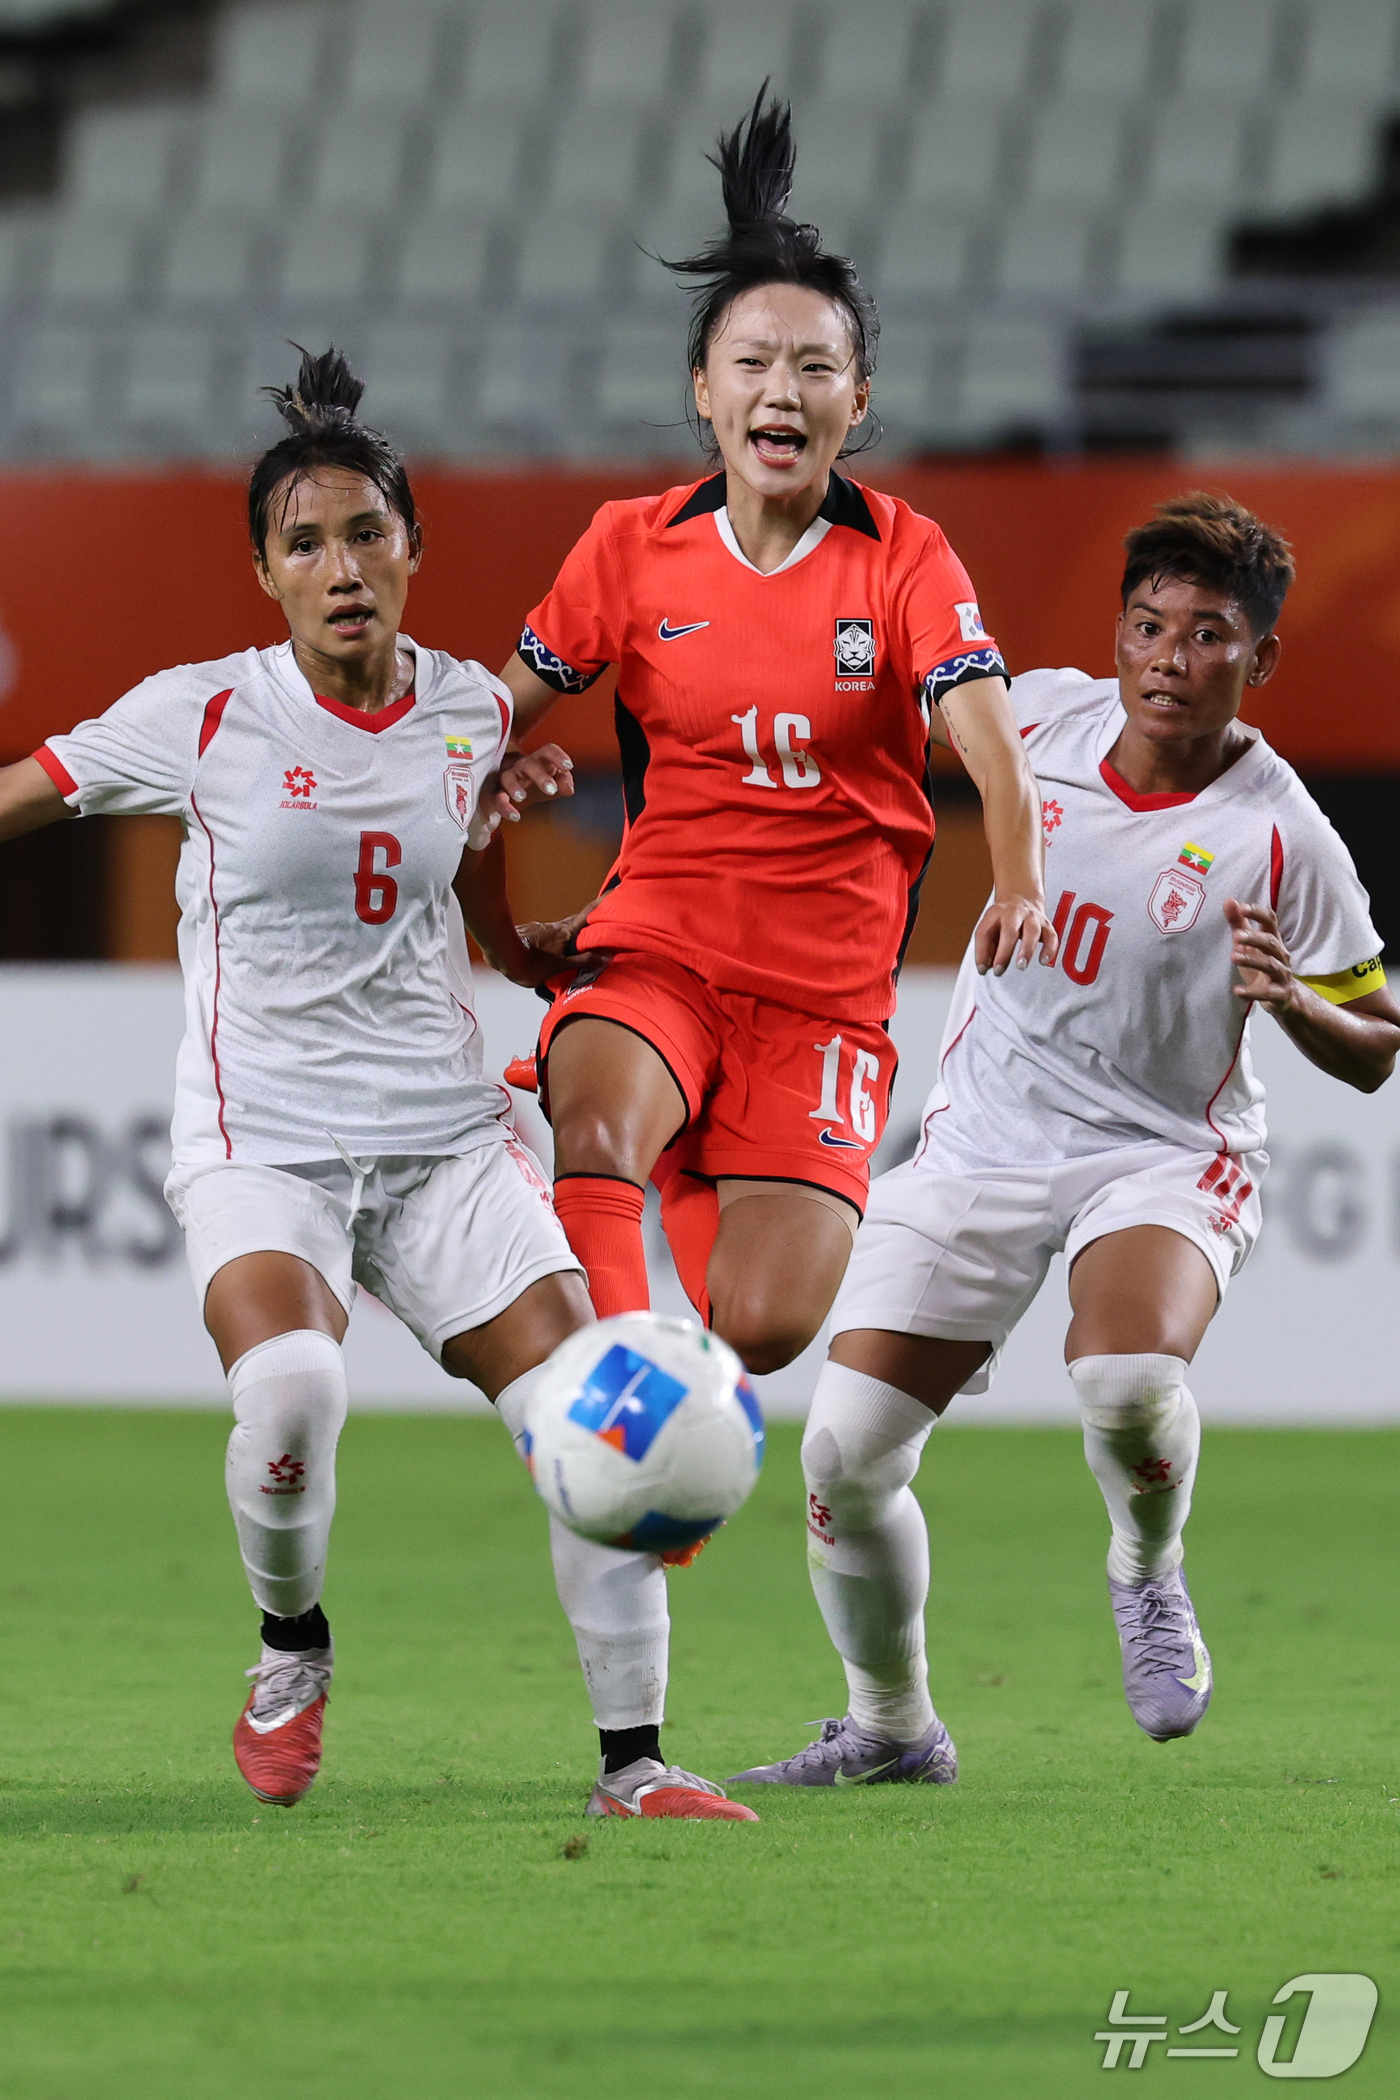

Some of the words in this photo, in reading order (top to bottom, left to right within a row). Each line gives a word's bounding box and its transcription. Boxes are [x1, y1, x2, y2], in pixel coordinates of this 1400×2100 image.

[834, 681, 876, 692] KOREA
[731, 703, 821, 788] 16
[353, 831, 402, 925] 6
[1045, 890, 1115, 986] 10
[808, 1033, 880, 1143] 16
